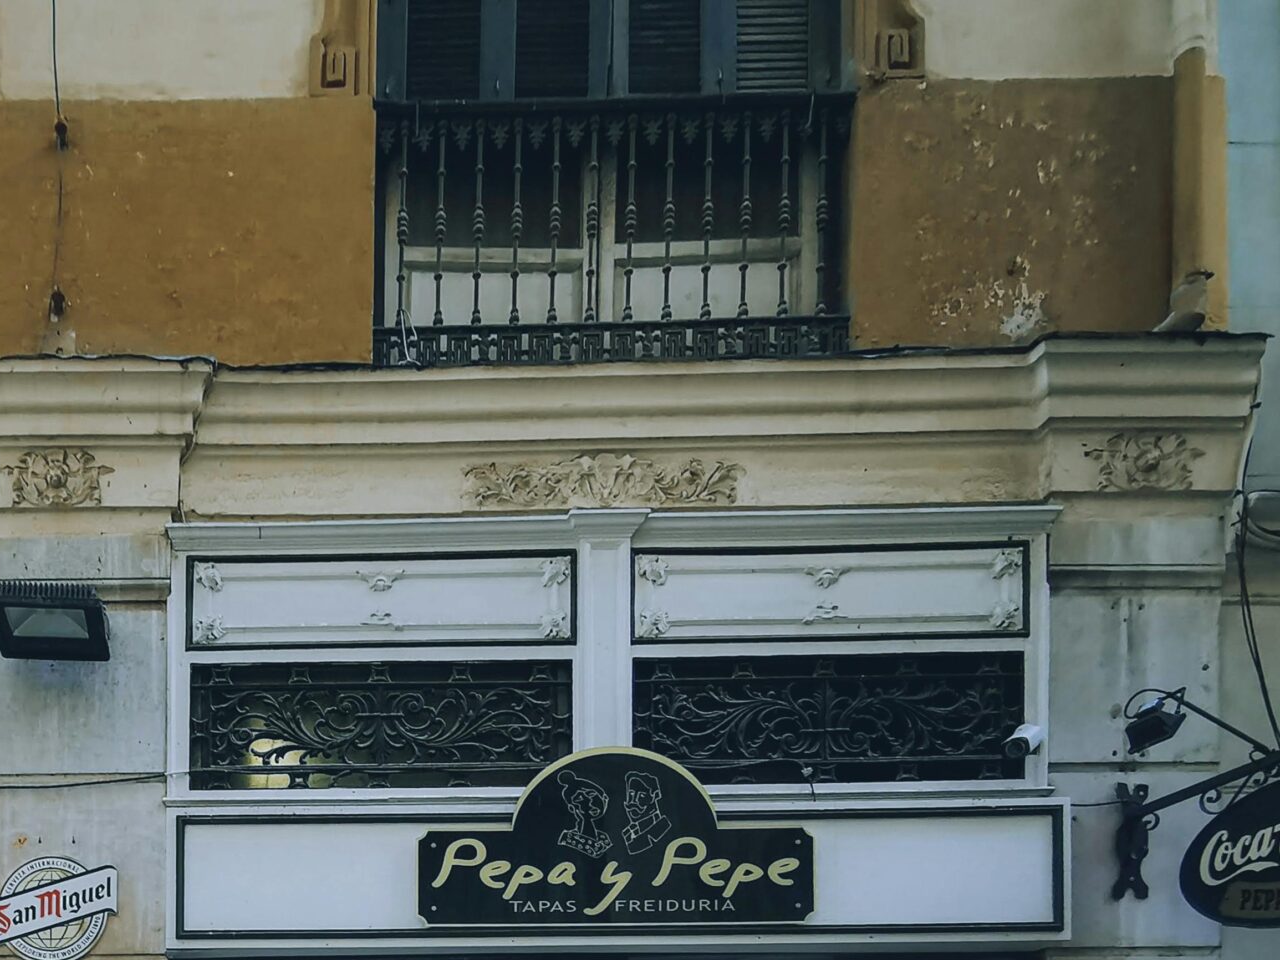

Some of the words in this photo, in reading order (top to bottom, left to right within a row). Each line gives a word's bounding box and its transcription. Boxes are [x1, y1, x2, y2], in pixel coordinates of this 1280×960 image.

[26, 859, 81, 873] INTERNACIONAL
[432, 838, 575, 900] Pepa
[583, 860, 632, 916] y
[652, 836, 800, 898] Pepe
[509, 900, 577, 913] TAPAS
[15, 940, 47, 959] EXPLORING
[61, 945, 82, 958] WORLD
[82, 928, 96, 947] SINCE
